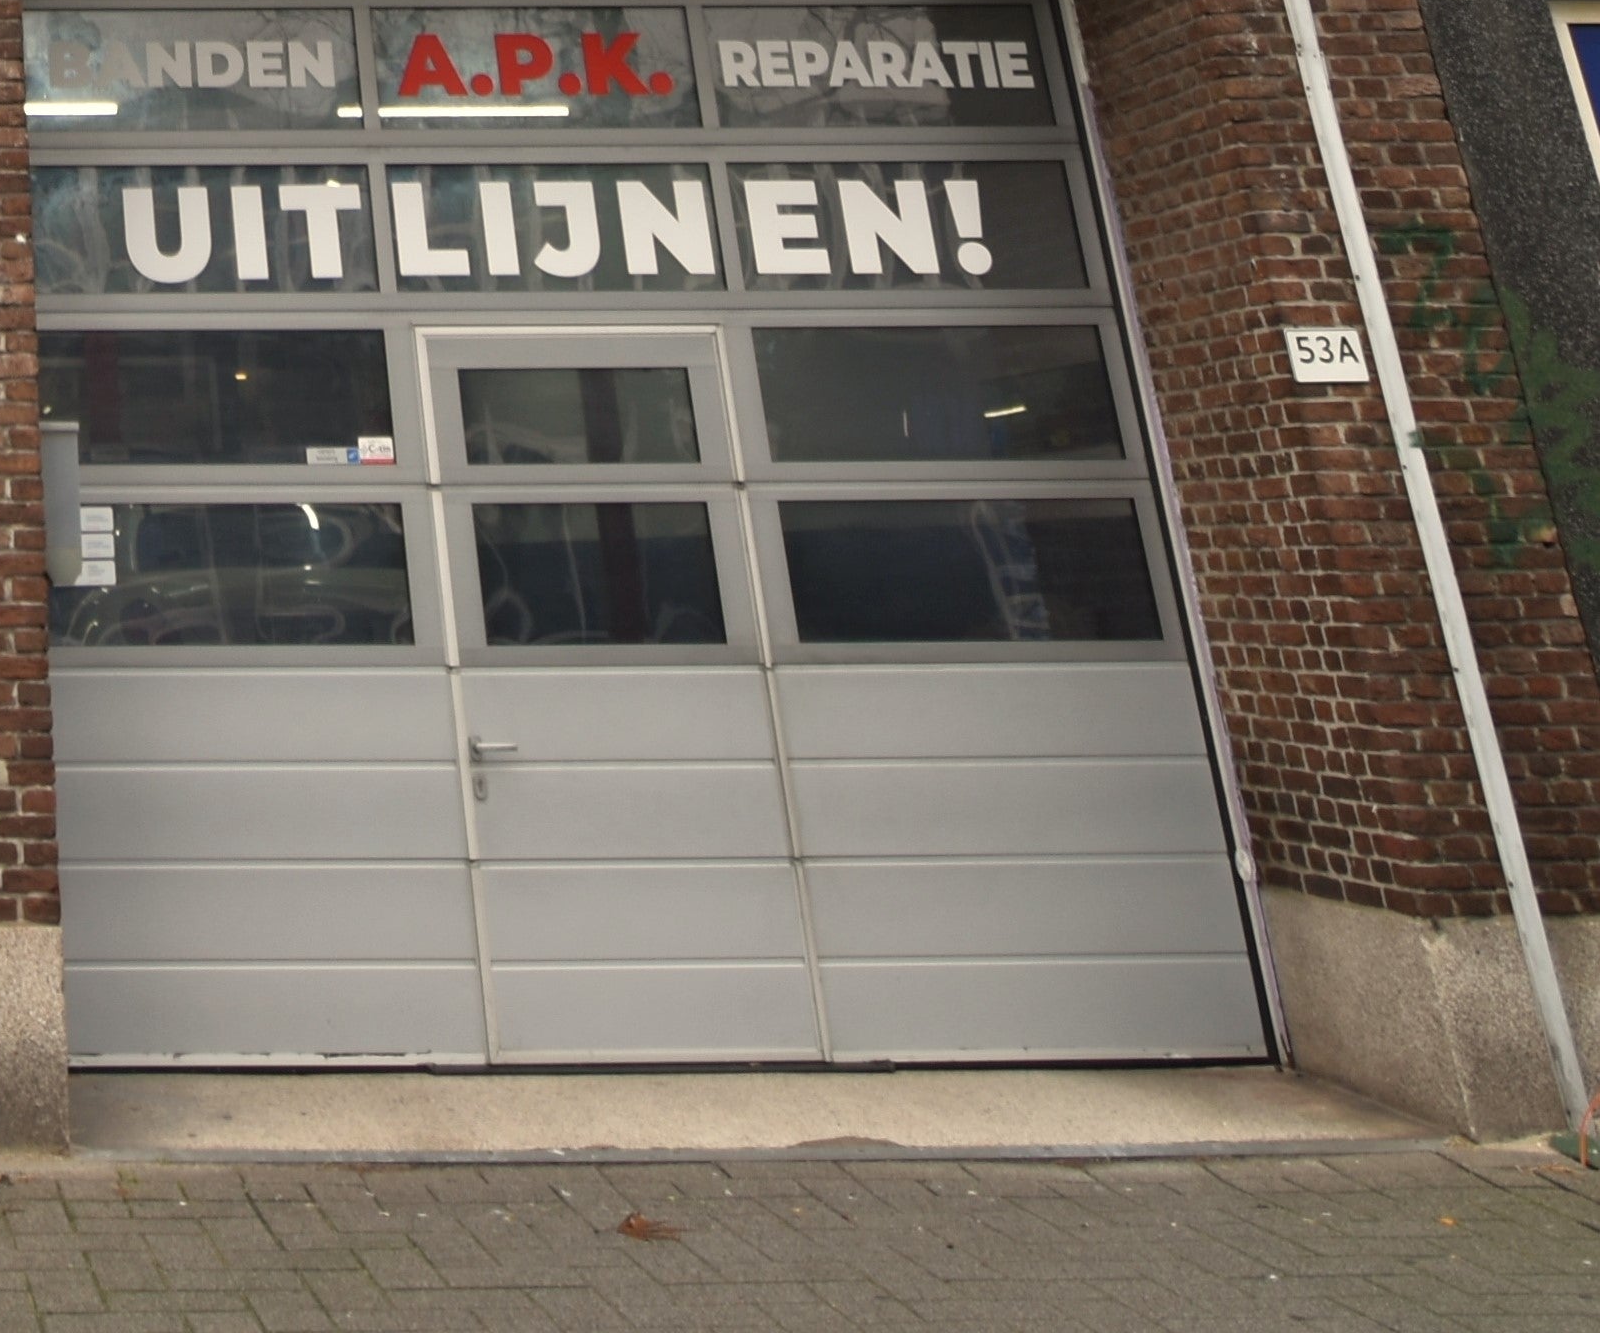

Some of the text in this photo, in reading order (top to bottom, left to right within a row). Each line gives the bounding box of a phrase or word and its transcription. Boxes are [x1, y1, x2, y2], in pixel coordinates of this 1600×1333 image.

[51, 41, 336, 88] BANDEN
[399, 31, 674, 97] A.P.K.
[719, 40, 1036, 90] REPARATIE
[1295, 336, 1360, 364] 53A
